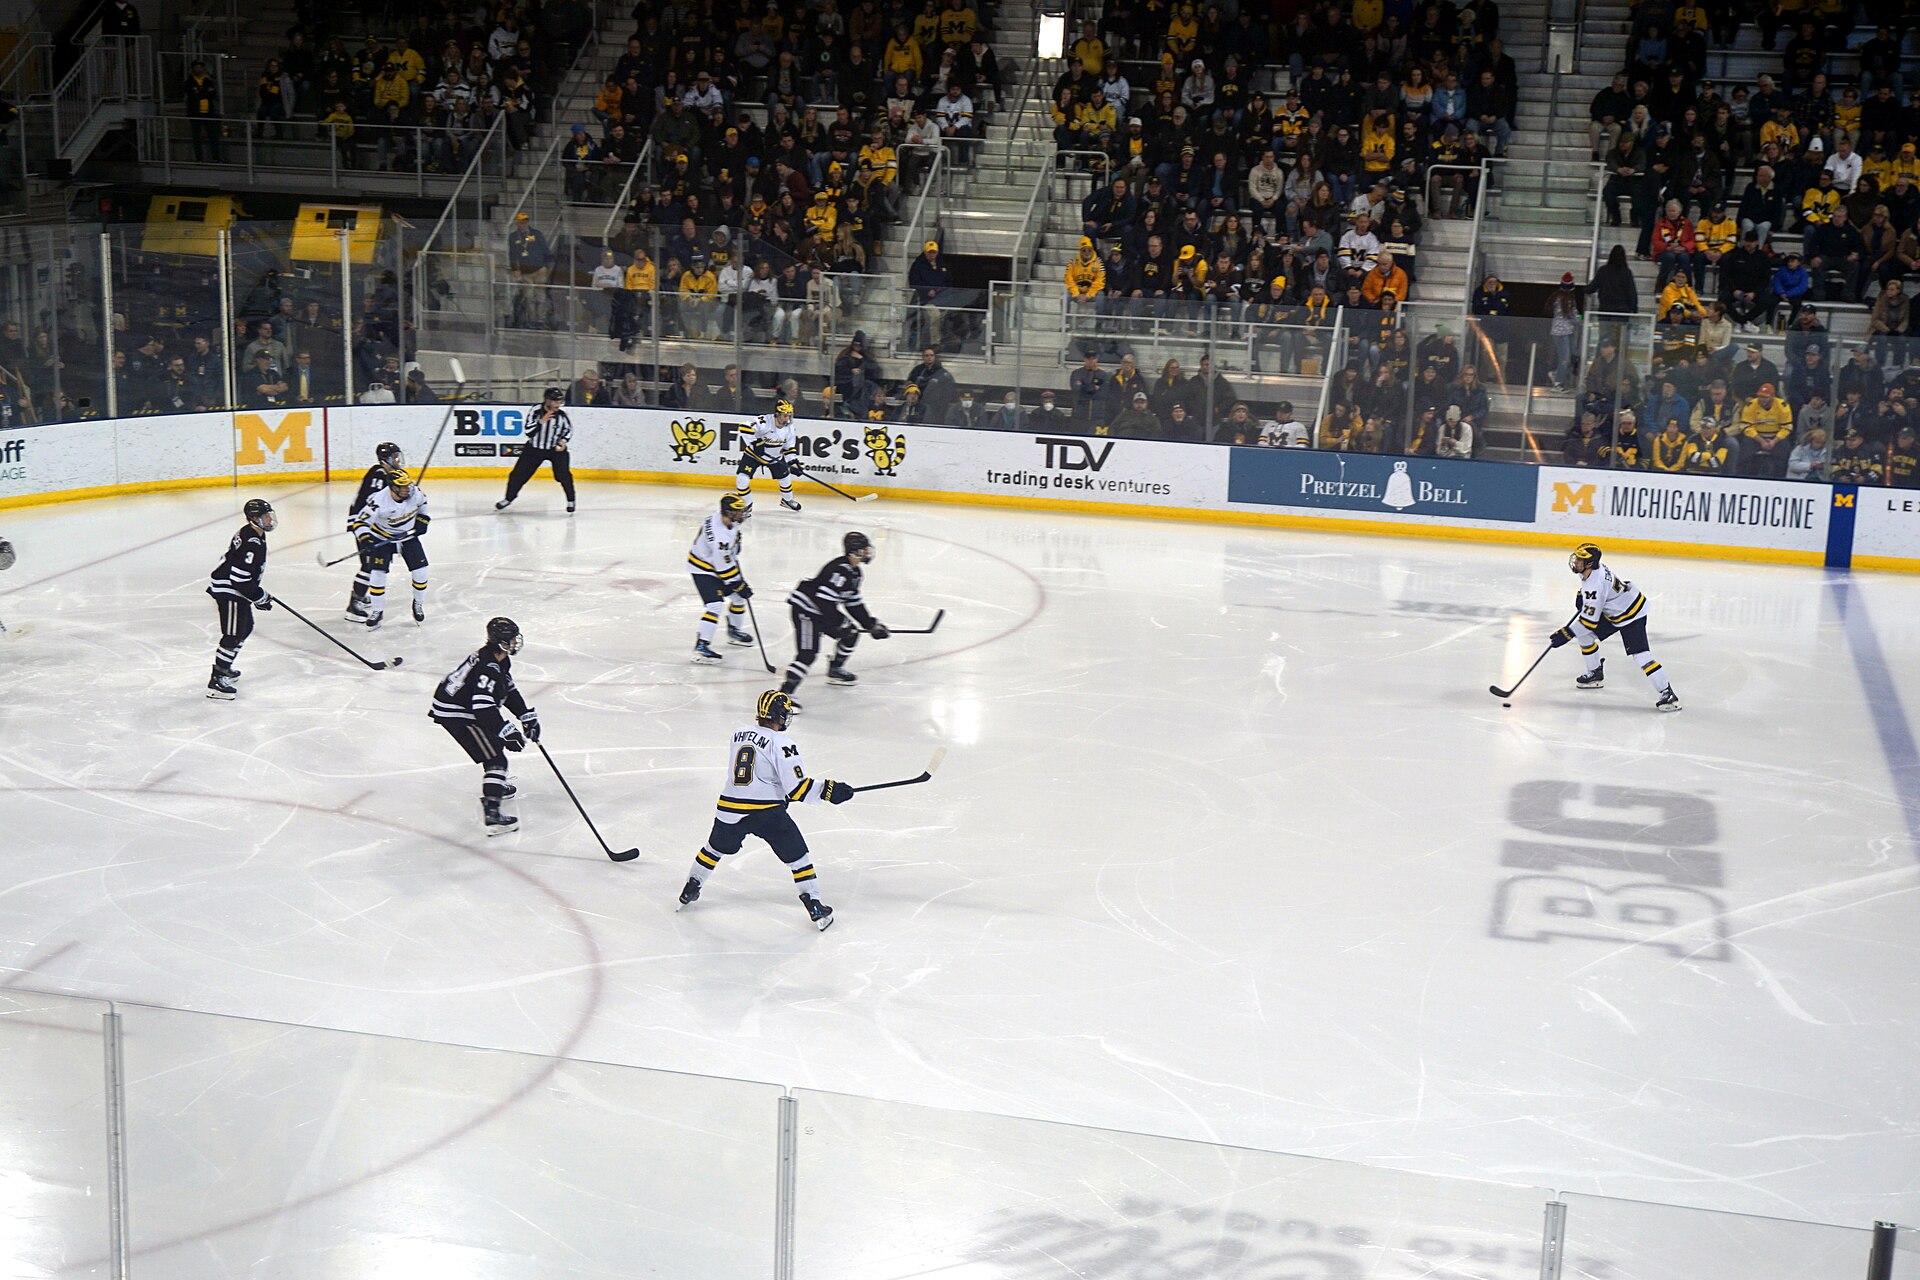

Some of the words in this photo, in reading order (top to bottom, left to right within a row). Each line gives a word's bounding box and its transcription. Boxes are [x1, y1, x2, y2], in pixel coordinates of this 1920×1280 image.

[868, 410, 884, 420] M
[235, 412, 312, 466] M
[1269, 431, 1289, 446] M
[0, 439, 25, 464] ff
[1035, 437, 1116, 472] TDV
[841, 465, 859, 474] Inc.
[987, 470, 1049, 489] trading
[1053, 473, 1095, 490] desk
[1097, 479, 1171, 495] ventures
[1418, 480, 1468, 504] BELL
[1551, 482, 1596, 514] M
[1610, 485, 1710, 522] MICHIGAN
[1717, 492, 1815, 529] MEDICINE
[1834, 493, 1855, 508] M
[1887, 499, 1920, 513] LE
[245, 551, 255, 564] 3
[1584, 590, 1597, 600] M
[1583, 604, 1596, 616] 73
[477, 674, 496, 693] 34
[781, 744, 799, 758] M
[733, 744, 757, 787] 8
[793, 765, 804, 779] 8
